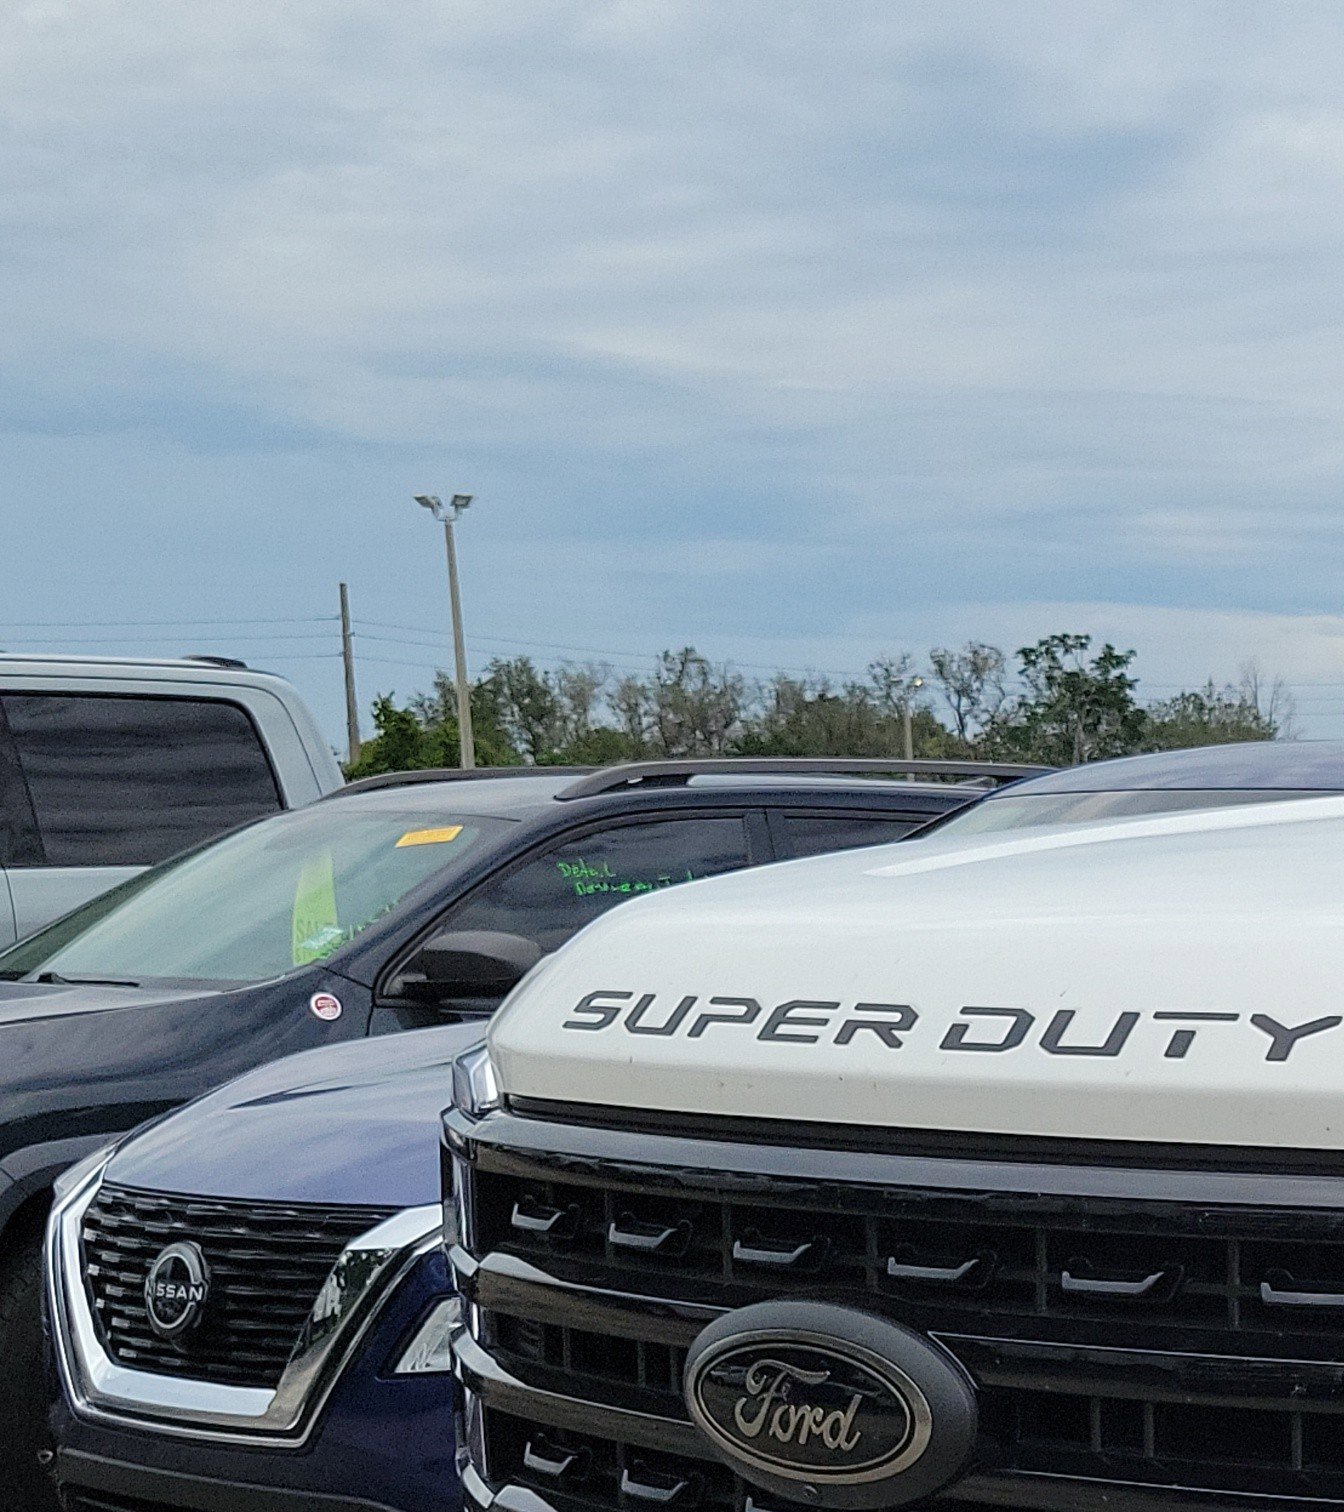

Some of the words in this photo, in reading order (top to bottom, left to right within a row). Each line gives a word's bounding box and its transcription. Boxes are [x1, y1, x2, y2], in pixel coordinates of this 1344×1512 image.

[562, 989, 922, 1049] SUPER
[938, 1005, 1344, 1062] DUTY
[150, 1281, 203, 1301] SSAN
[734, 1358, 864, 1451] Ford
